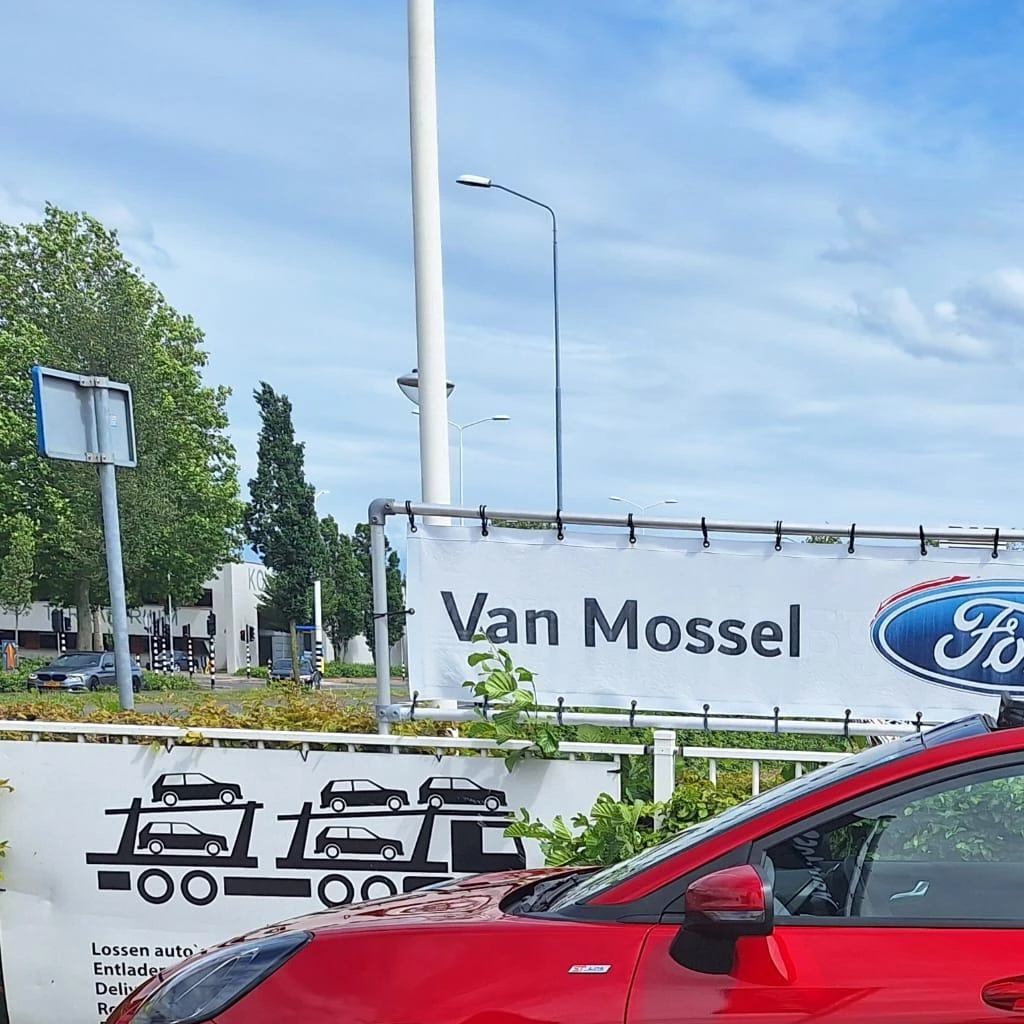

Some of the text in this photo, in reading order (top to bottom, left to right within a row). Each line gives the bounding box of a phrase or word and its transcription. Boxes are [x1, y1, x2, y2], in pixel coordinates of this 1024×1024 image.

[440, 590, 800, 657] Van Mossel
[92, 942, 150, 957] Lossen
